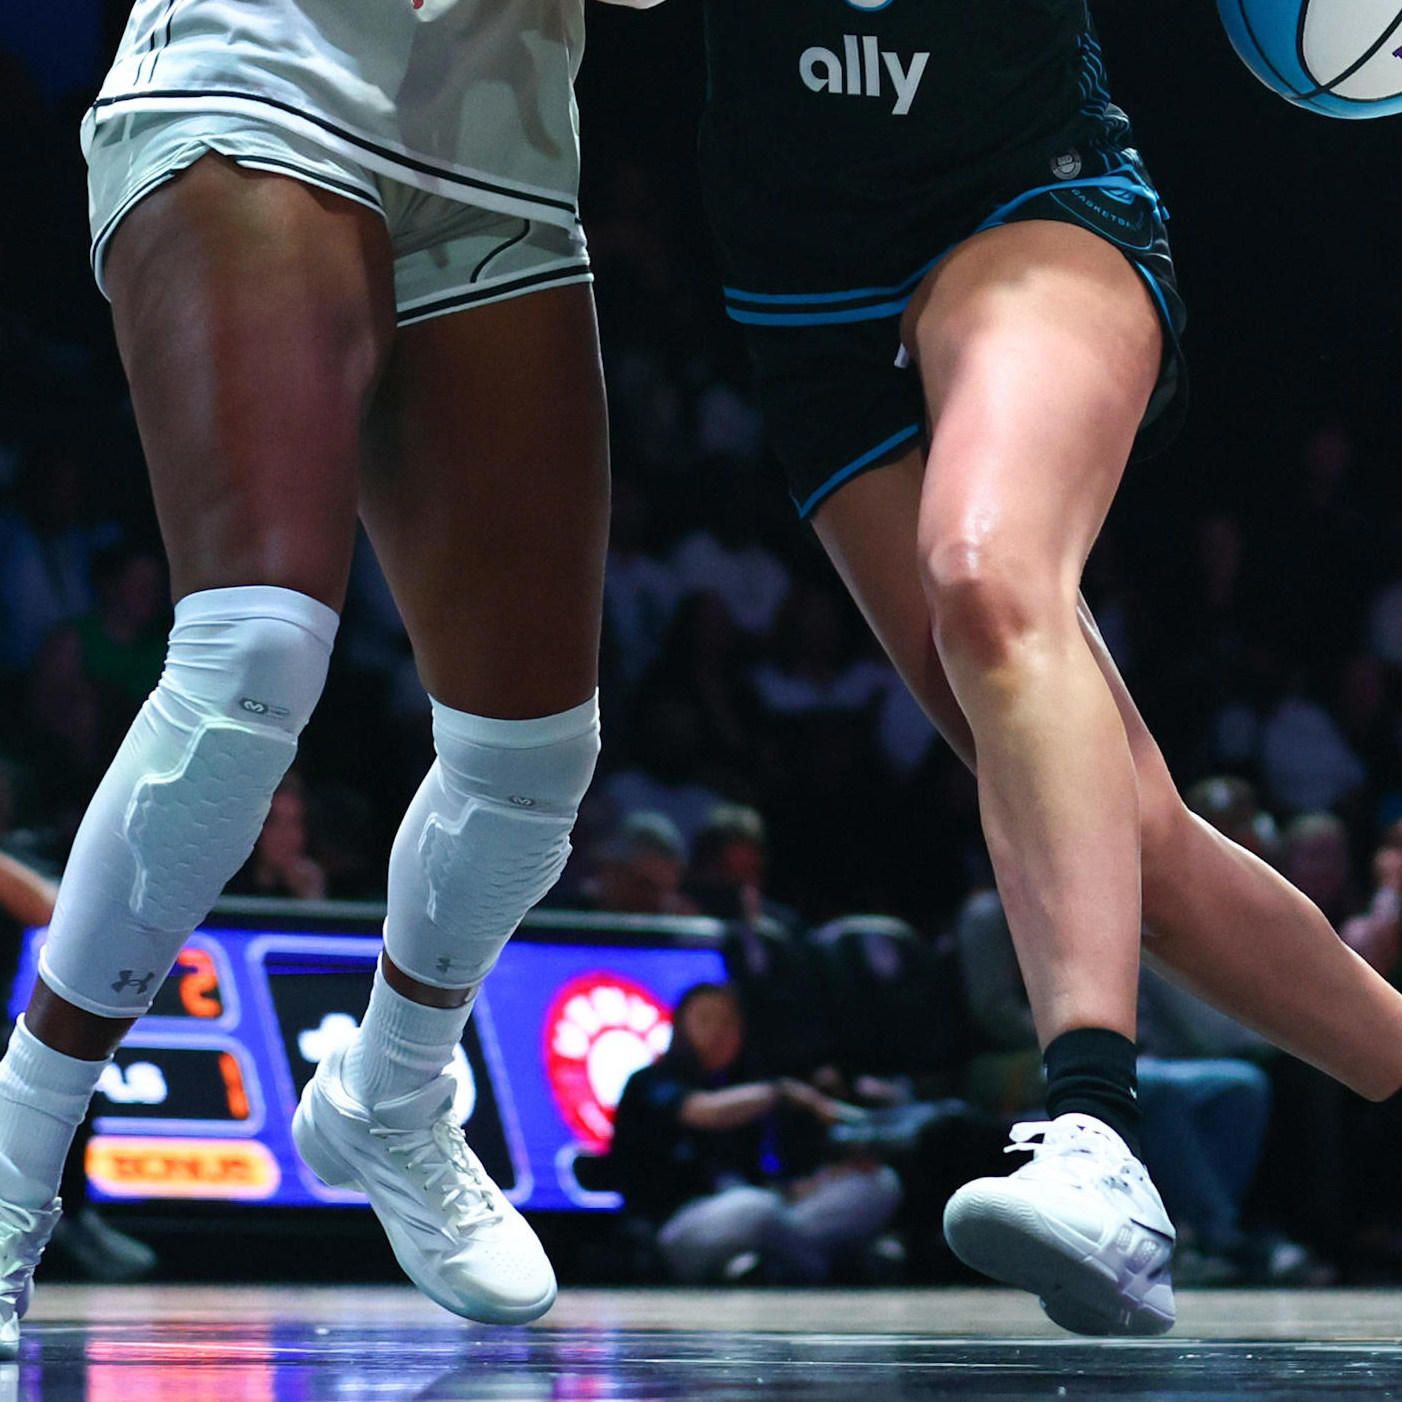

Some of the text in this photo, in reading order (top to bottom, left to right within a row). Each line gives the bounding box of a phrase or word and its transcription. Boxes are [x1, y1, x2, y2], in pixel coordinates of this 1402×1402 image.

[799, 34, 931, 116] ally
[218, 1051, 250, 1120] 1
[110, 1152, 252, 1183] BONUS
